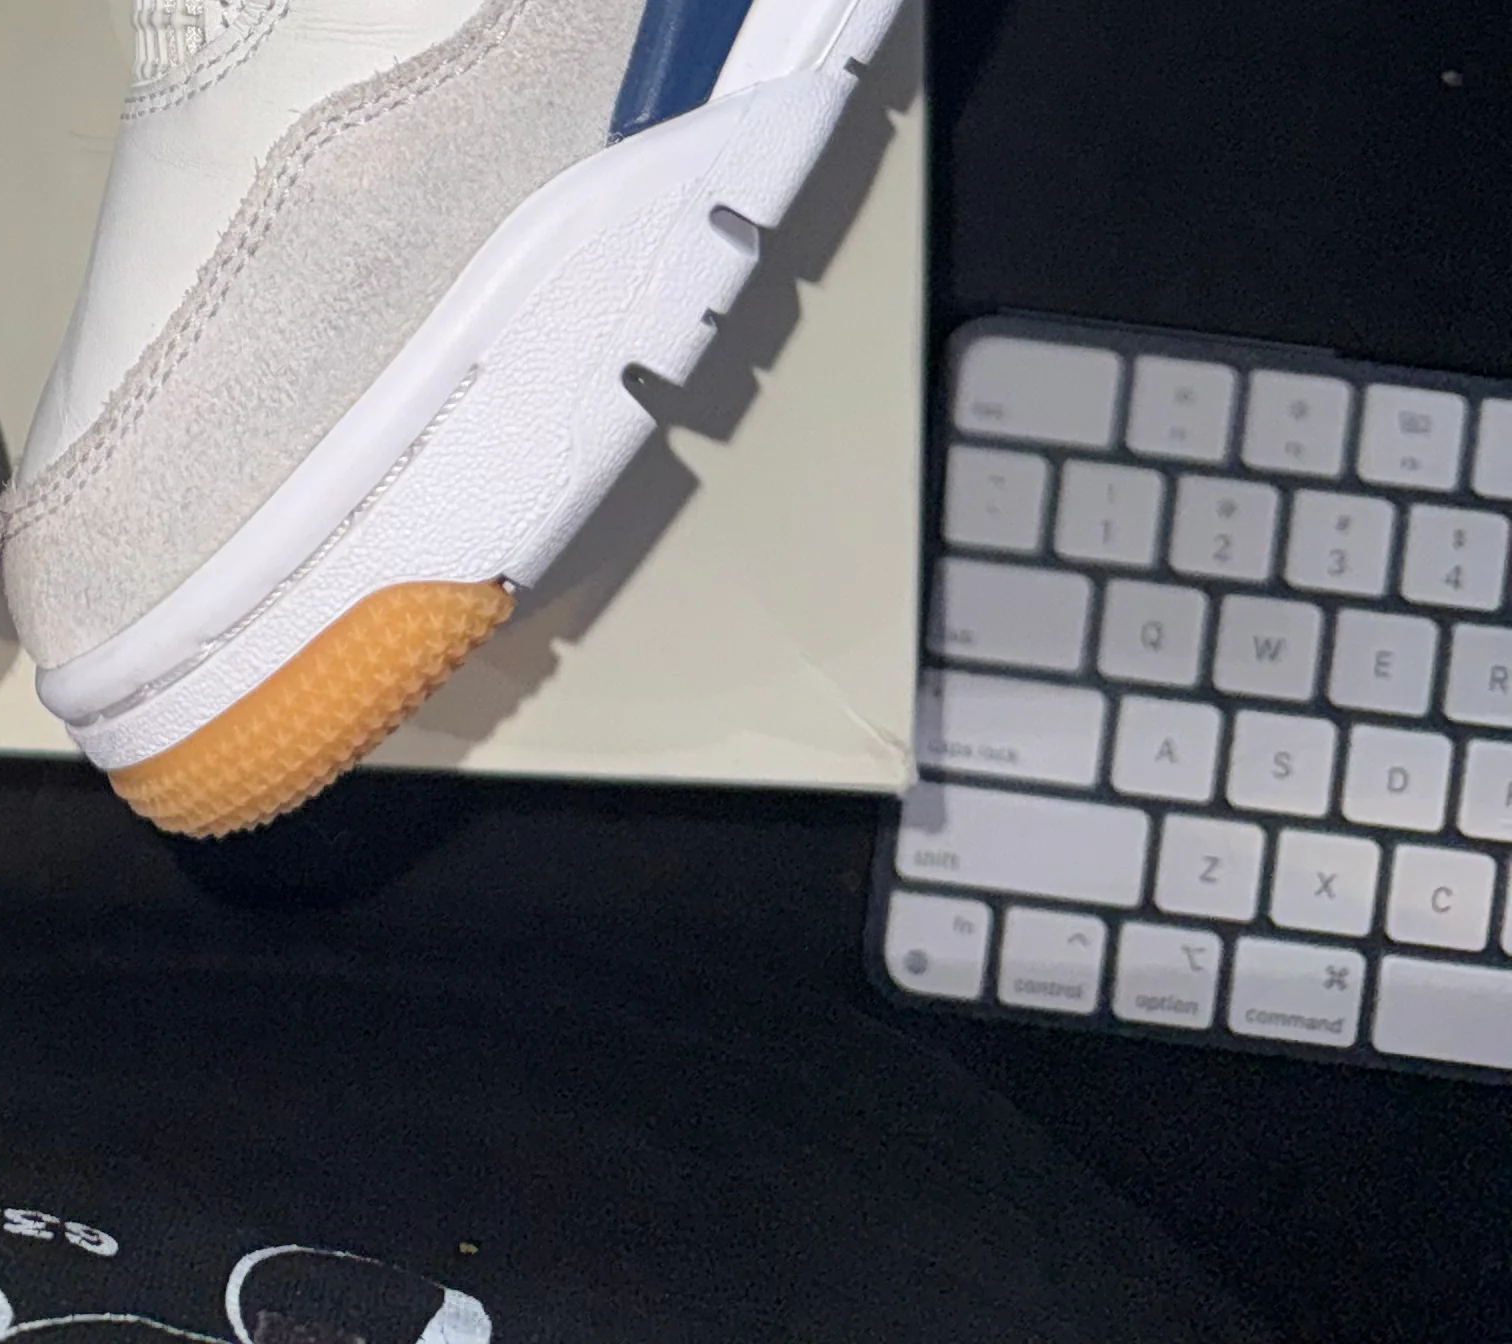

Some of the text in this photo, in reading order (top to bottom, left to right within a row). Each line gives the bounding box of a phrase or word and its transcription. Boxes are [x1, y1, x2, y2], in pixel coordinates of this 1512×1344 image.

[1213, 533, 1233, 563] 2
[1327, 548, 1349, 577] 3
[1445, 564, 1463, 591] 4
[1140, 620, 1164, 651] Q
[1253, 635, 1286, 663] W
[1374, 650, 1394, 679] E
[1489, 665, 1510, 694] R
[1154, 736, 1179, 764] A
[1272, 751, 1293, 779] S
[1387, 767, 1409, 794] D
[1199, 856, 1222, 884] Z
[1313, 871, 1337, 900] X
[1430, 886, 1453, 914] C
[1013, 977, 1086, 1000] control
[1135, 994, 1199, 1017] option
[1245, 1007, 1345, 1035] command
